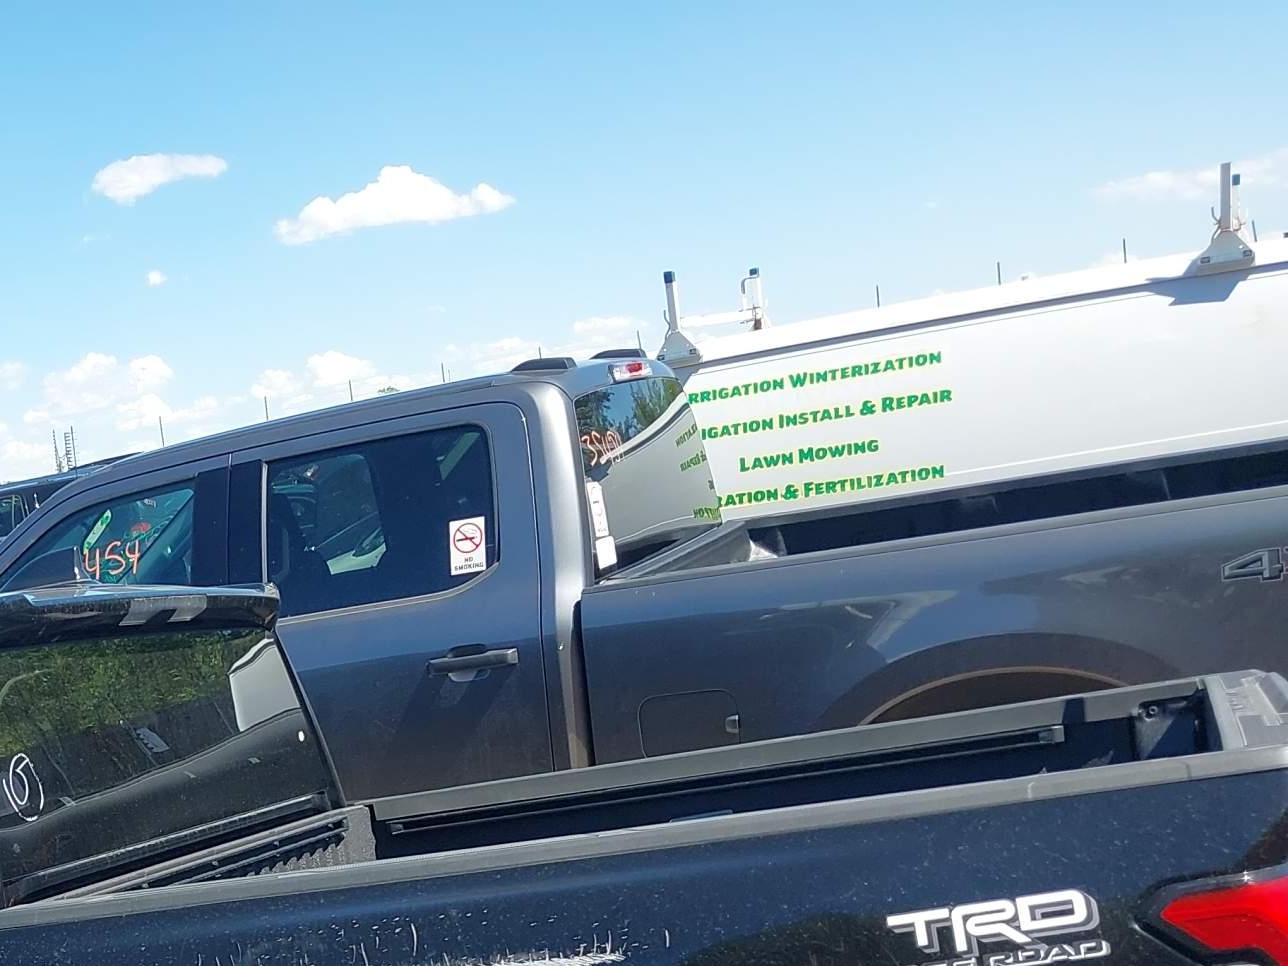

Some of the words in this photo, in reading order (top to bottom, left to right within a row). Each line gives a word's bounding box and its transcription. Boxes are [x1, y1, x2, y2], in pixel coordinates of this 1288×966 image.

[788, 351, 942, 389] WINTERIZATION
[778, 408, 854, 428] INSTALL
[859, 400, 876, 415] &
[881, 389, 952, 412] REPAIR
[739, 452, 793, 472] LAWN
[798, 439, 879, 463] MOWING
[781, 484, 799, 501] &
[803, 465, 944, 498] FERTILIZATION
[454, 561, 484, 572] SMOKING
[886, 888, 1100, 956] TRD
